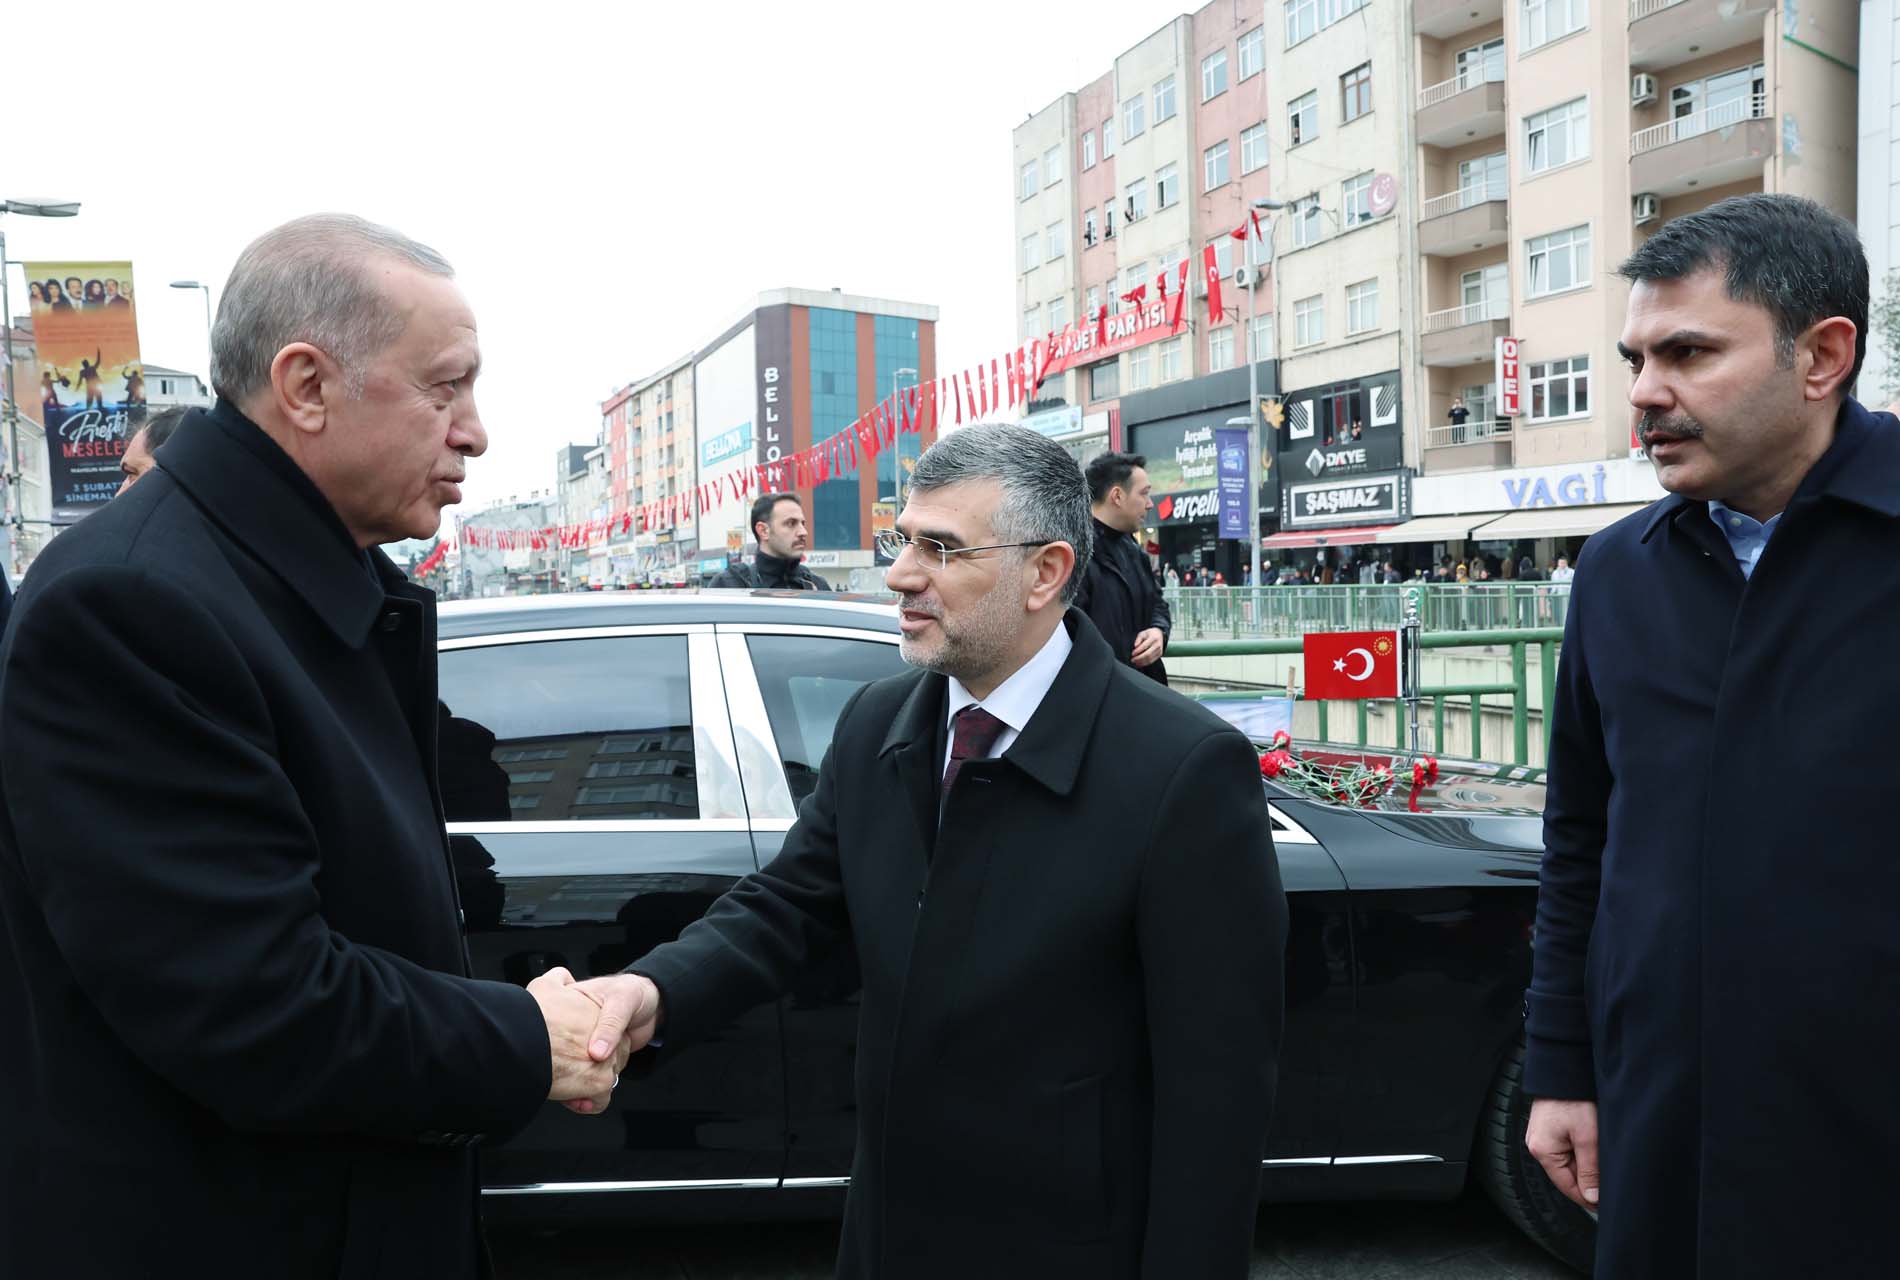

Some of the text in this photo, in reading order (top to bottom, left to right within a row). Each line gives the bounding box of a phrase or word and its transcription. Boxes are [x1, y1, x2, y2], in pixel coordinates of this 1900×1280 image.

[1504, 340, 1518, 413] OTEL
[65, 493, 113, 502] SİNEMAL
[1305, 486, 1380, 515] ŞAŞMAZ
[1502, 464, 1607, 507] VAGİ
[1173, 489, 1219, 522] arçeli
